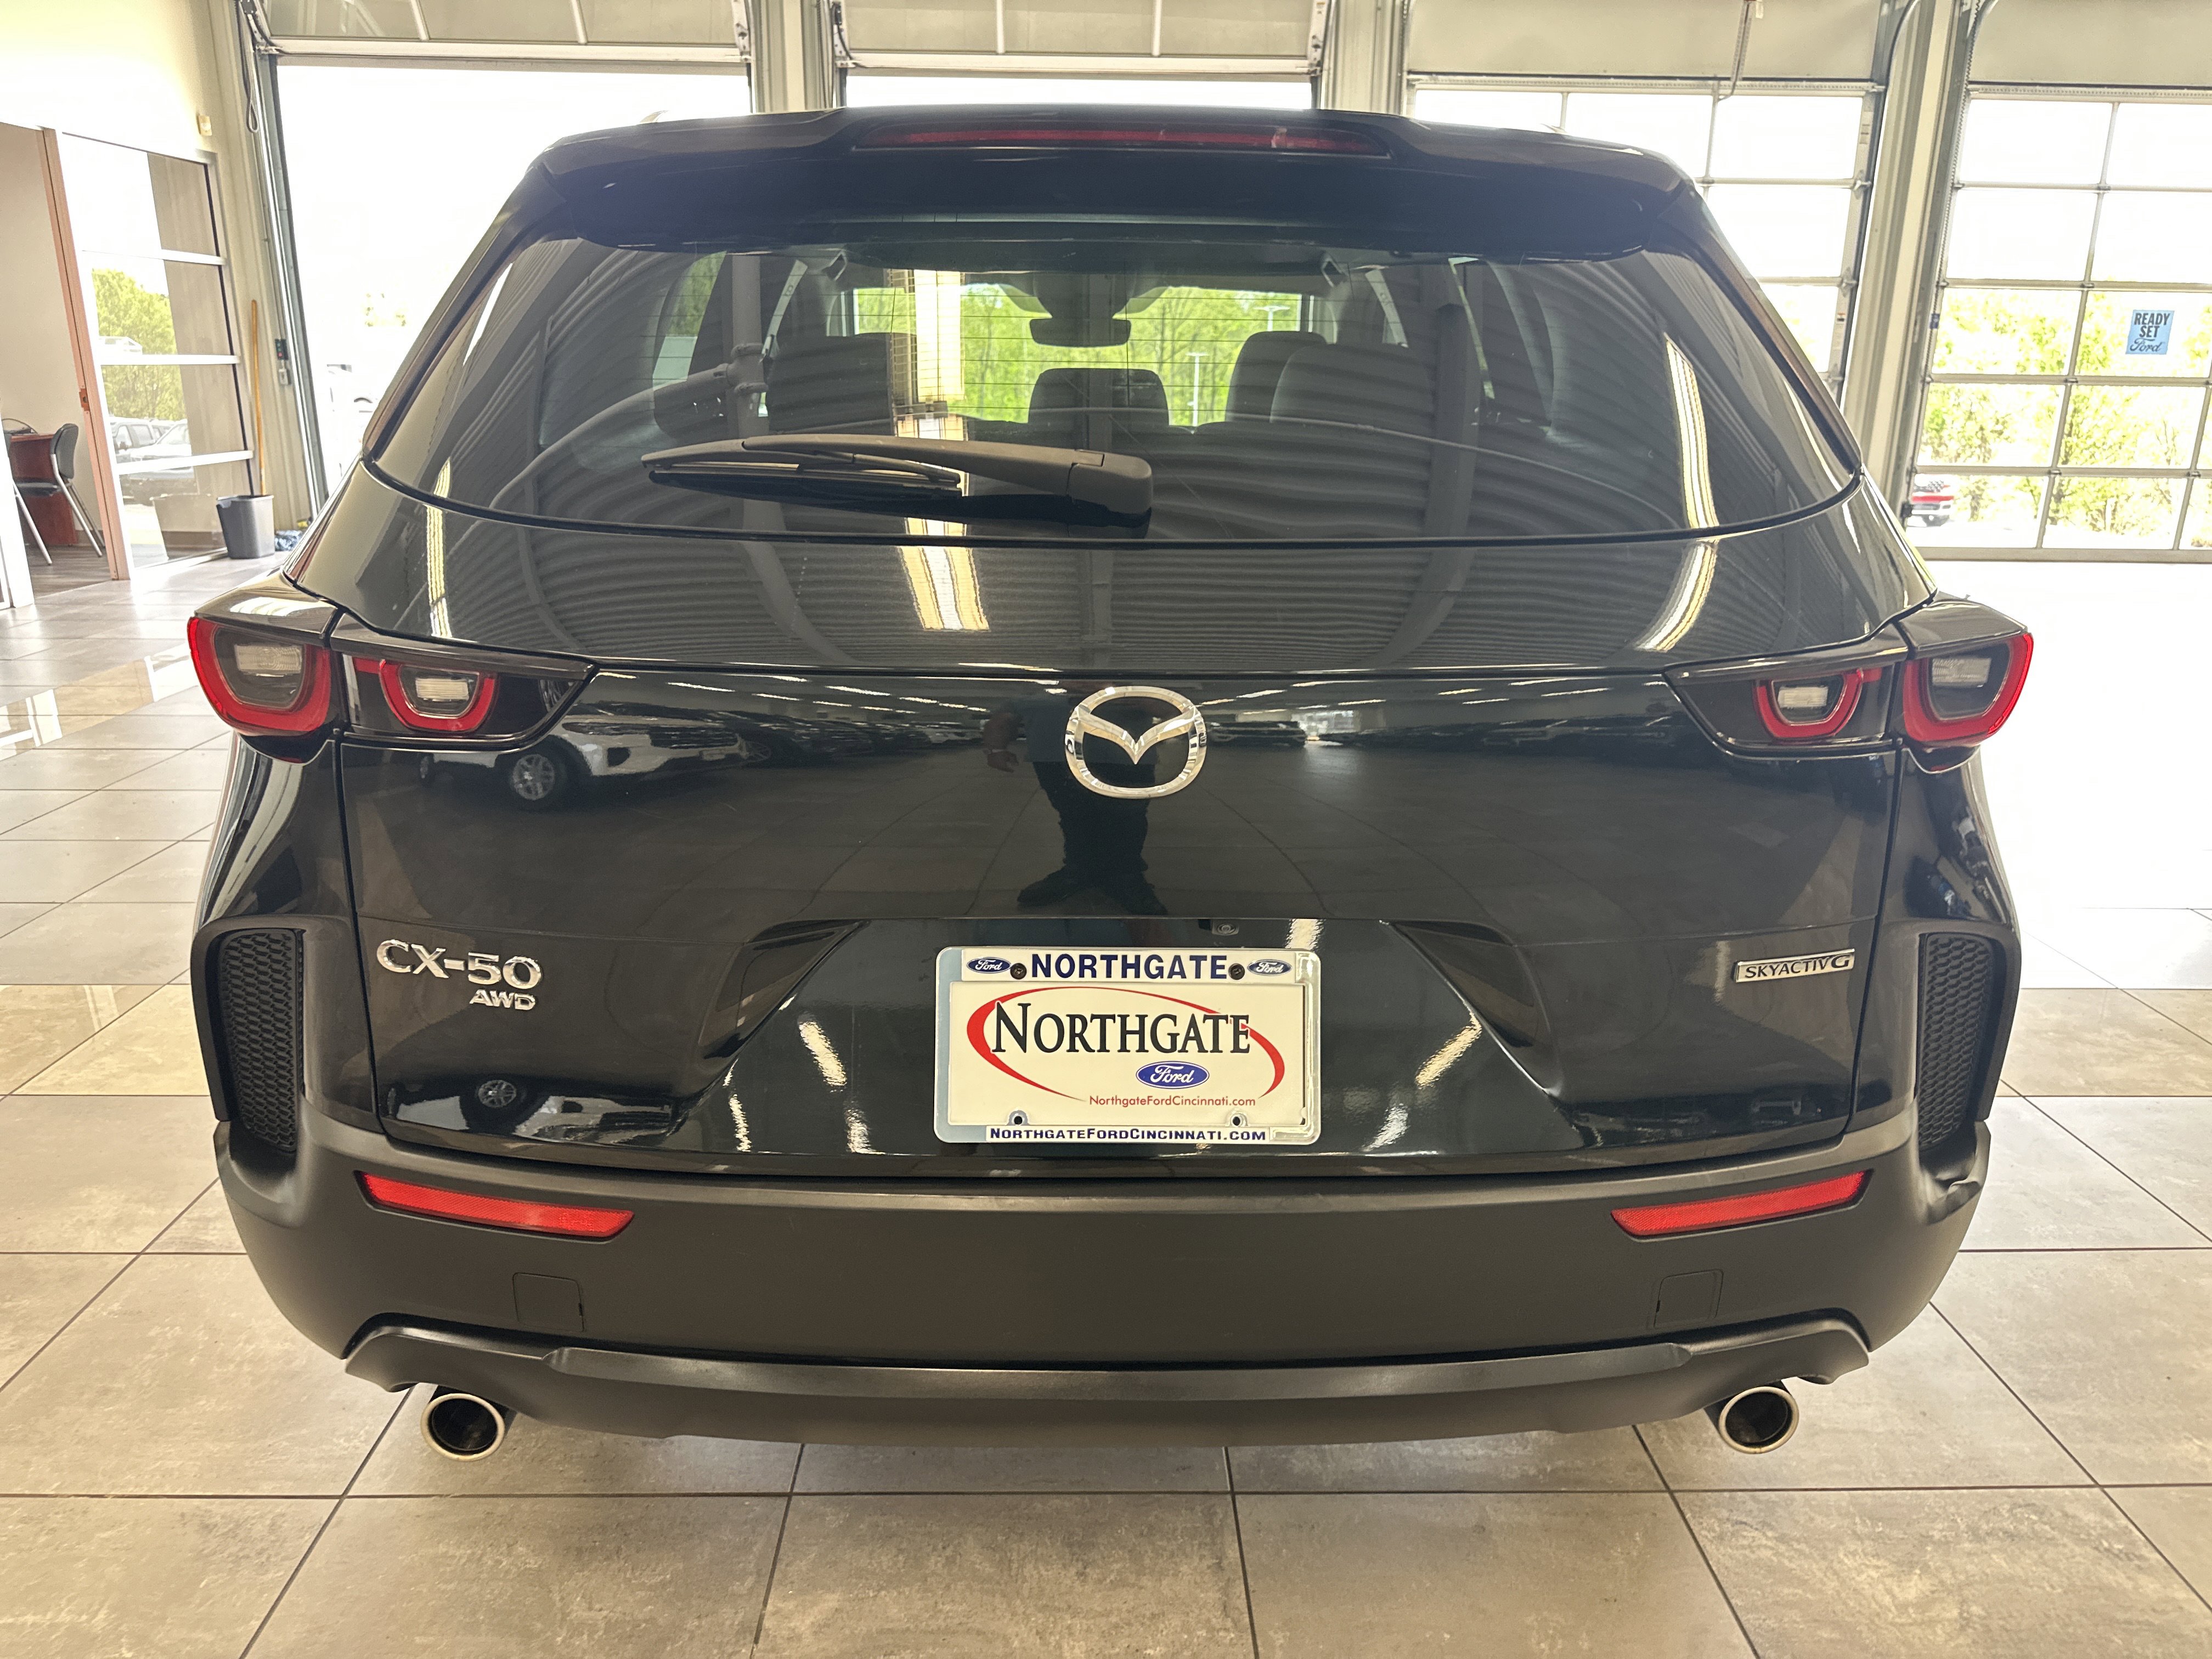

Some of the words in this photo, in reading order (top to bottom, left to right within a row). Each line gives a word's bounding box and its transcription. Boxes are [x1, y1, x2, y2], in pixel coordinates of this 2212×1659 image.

[2134, 312, 2171, 326] READY
[2139, 325, 2160, 338] SET
[2130, 337, 2166, 352] Ford
[376, 939, 543, 990] CX-50
[975, 960, 1003, 970] Ford
[1032, 953, 1227, 979] NORTHGATE
[1256, 962, 1284, 973] Ford
[469, 989, 536, 1011] AWD
[991, 1001, 1250, 1054] NORTHGATE
[1150, 1064, 1194, 1084] Ford
[1089, 1094, 1256, 1108] NorthgateFordCincinnati.com
